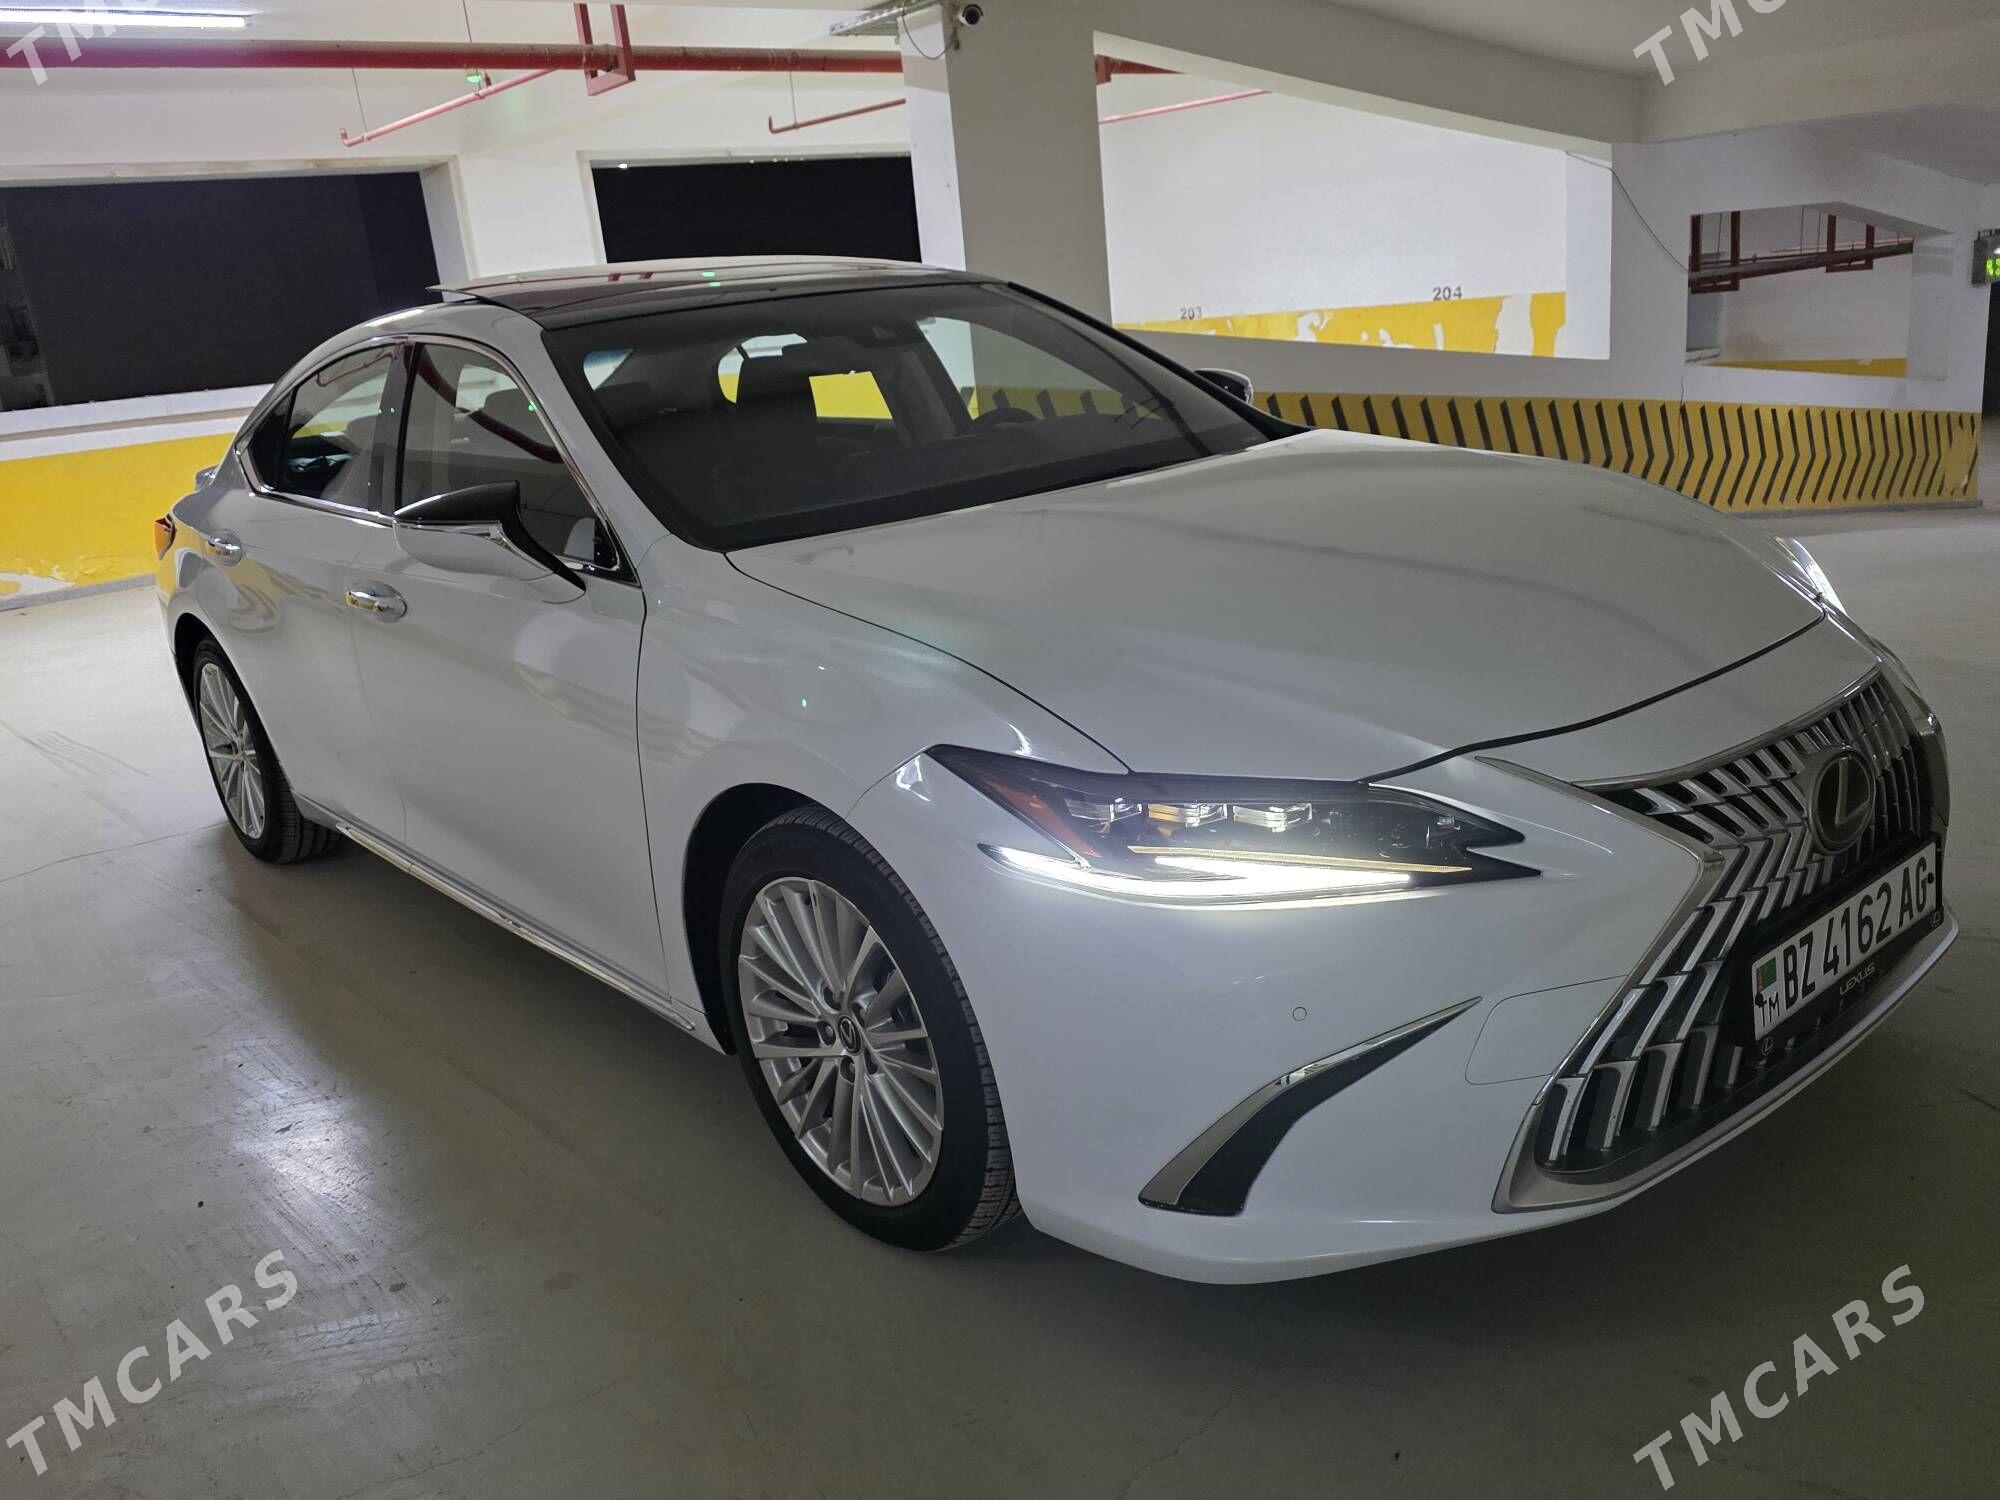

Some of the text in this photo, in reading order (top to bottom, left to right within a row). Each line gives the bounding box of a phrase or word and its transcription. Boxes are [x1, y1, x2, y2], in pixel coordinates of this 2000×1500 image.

[1432, 285, 1463, 301] 204
[1783, 857, 1928, 1010] BZ 4162 AG
[1839, 961, 1875, 996] LEXUS
[1758, 992, 1780, 1028] TM
